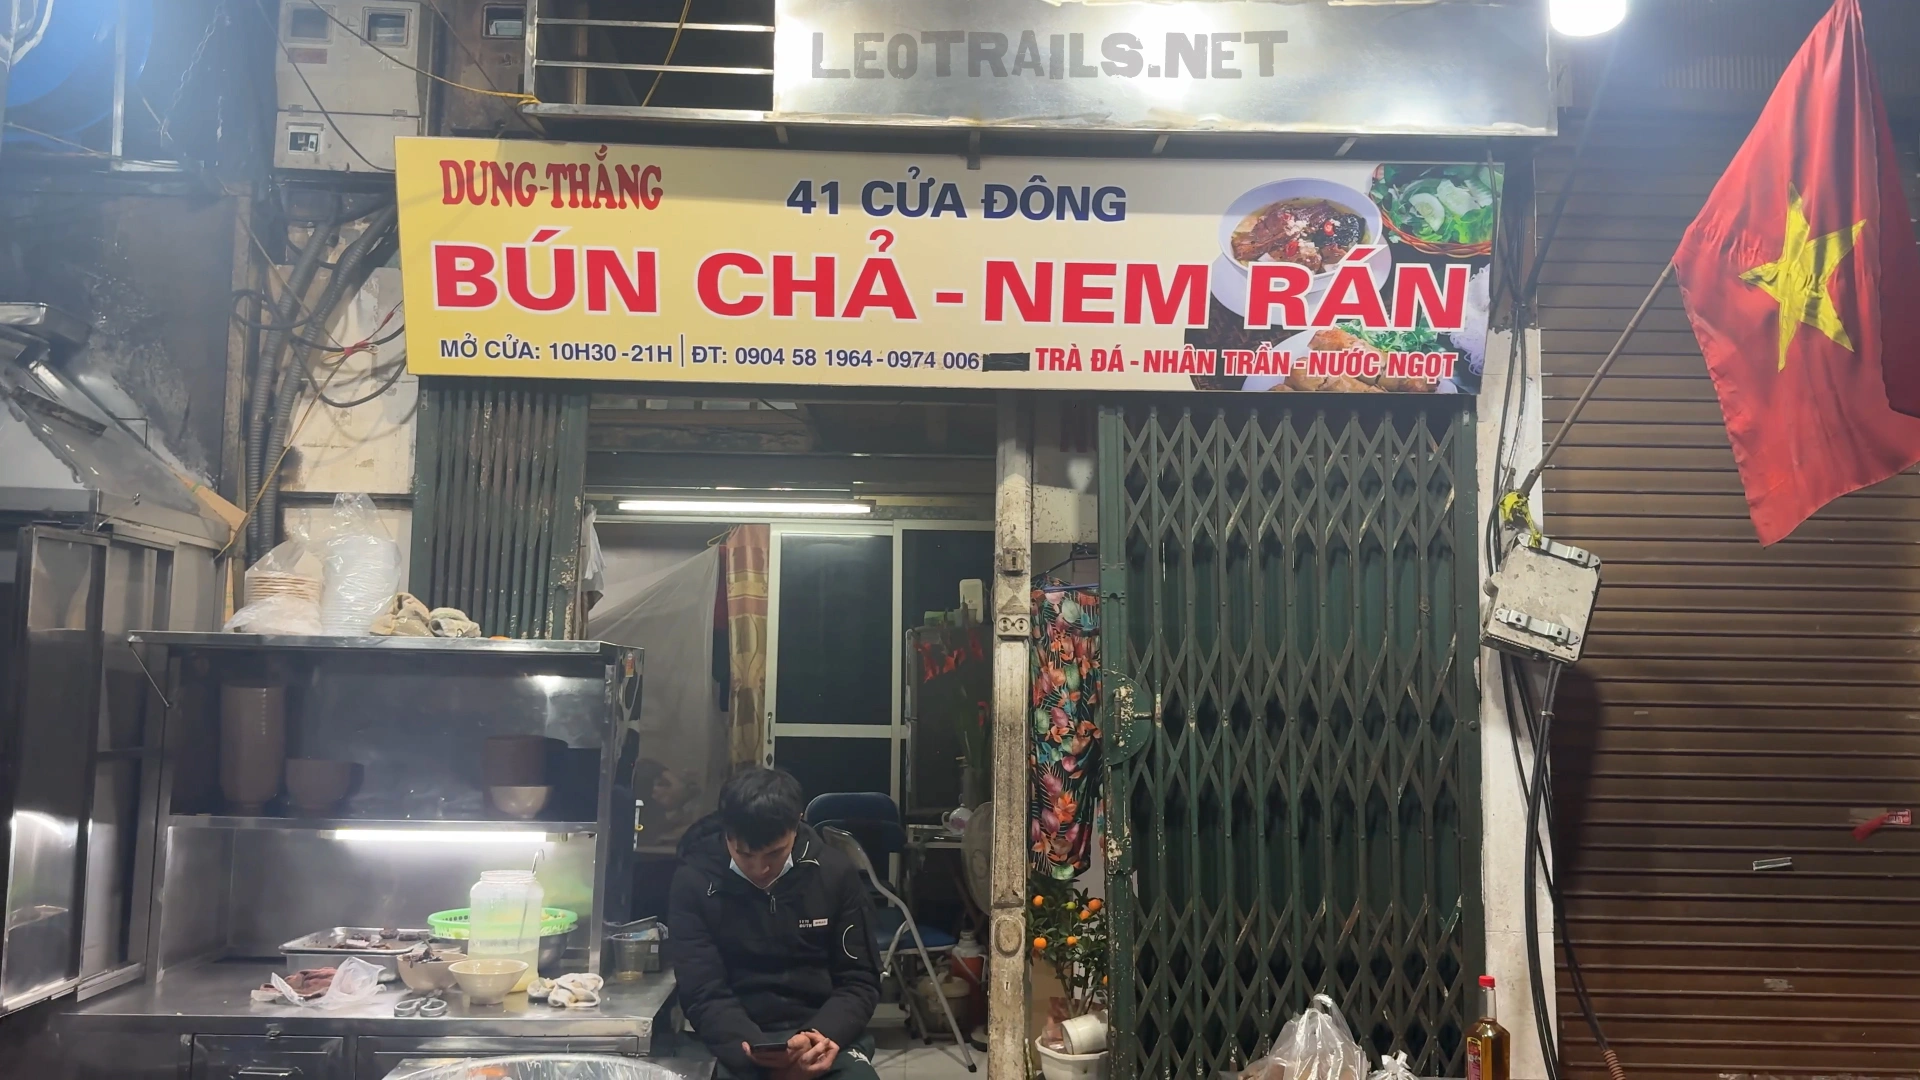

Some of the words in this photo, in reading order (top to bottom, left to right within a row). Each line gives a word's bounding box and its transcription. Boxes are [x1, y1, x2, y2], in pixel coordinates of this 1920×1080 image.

[439, 144, 664, 210] DUNG-THẮNG
[786, 180, 839, 215] 41
[861, 166, 968, 219] CỬA
[981, 174, 1127, 222] ĐÔNG
[433, 229, 658, 313] BÚN
[697, 229, 918, 320] CHẢ
[984, 260, 1210, 326] NEM
[1246, 247, 1470, 330] RÁN
[440, 332, 478, 358] MỞ
[484, 333, 541, 360] CỬA:
[691, 345, 727, 364] ĐT:
[735, 347, 785, 365] 0904
[792, 348, 817, 366] 58
[943, 352, 980, 370] 006
[1035, 343, 1083, 372] TRÀ
[1090, 344, 1125, 373] ĐÁ
[1143, 346, 1216, 375] NHÂN
[1223, 343, 1290, 376] TRẦN
[1309, 347, 1380, 377] NƯỚC
[1387, 352, 1458, 383] NGỌT
